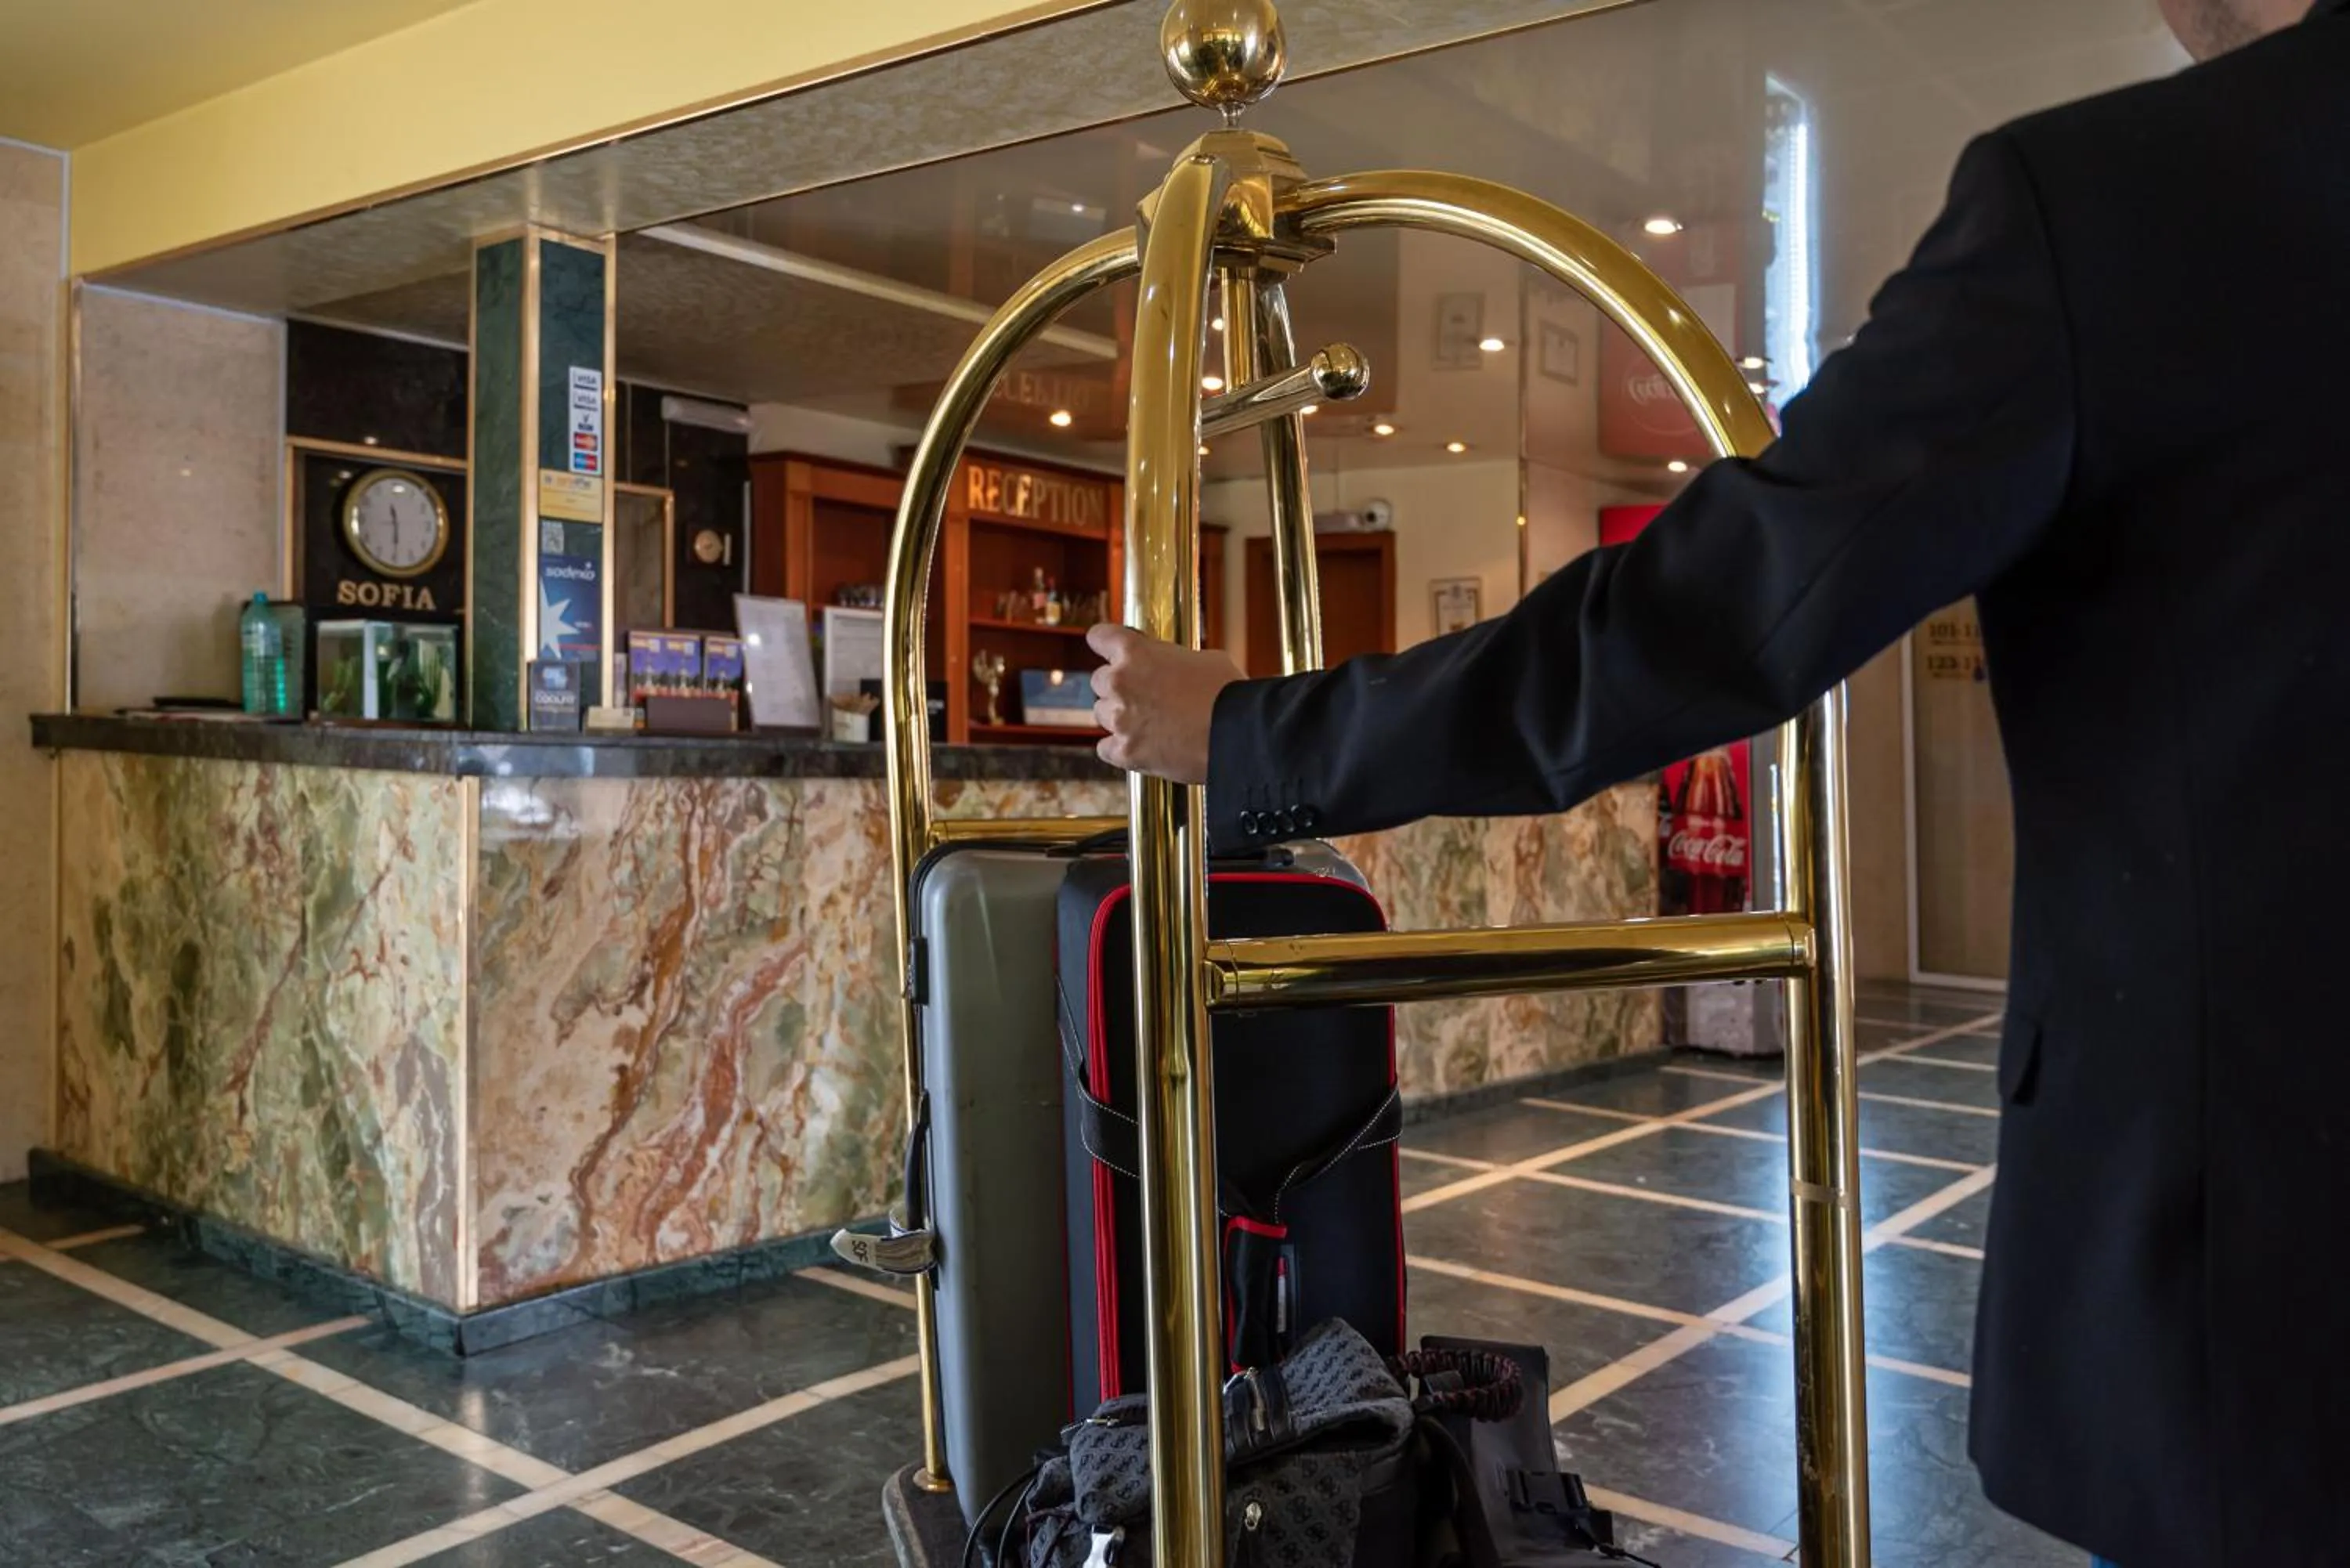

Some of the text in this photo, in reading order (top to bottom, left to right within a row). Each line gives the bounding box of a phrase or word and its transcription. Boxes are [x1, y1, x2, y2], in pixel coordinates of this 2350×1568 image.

[577, 375, 596, 385] VISA
[968, 465, 1104, 526] RECEPTION
[545, 564, 595, 580] sodexo
[337, 580, 437, 612] SOFIA
